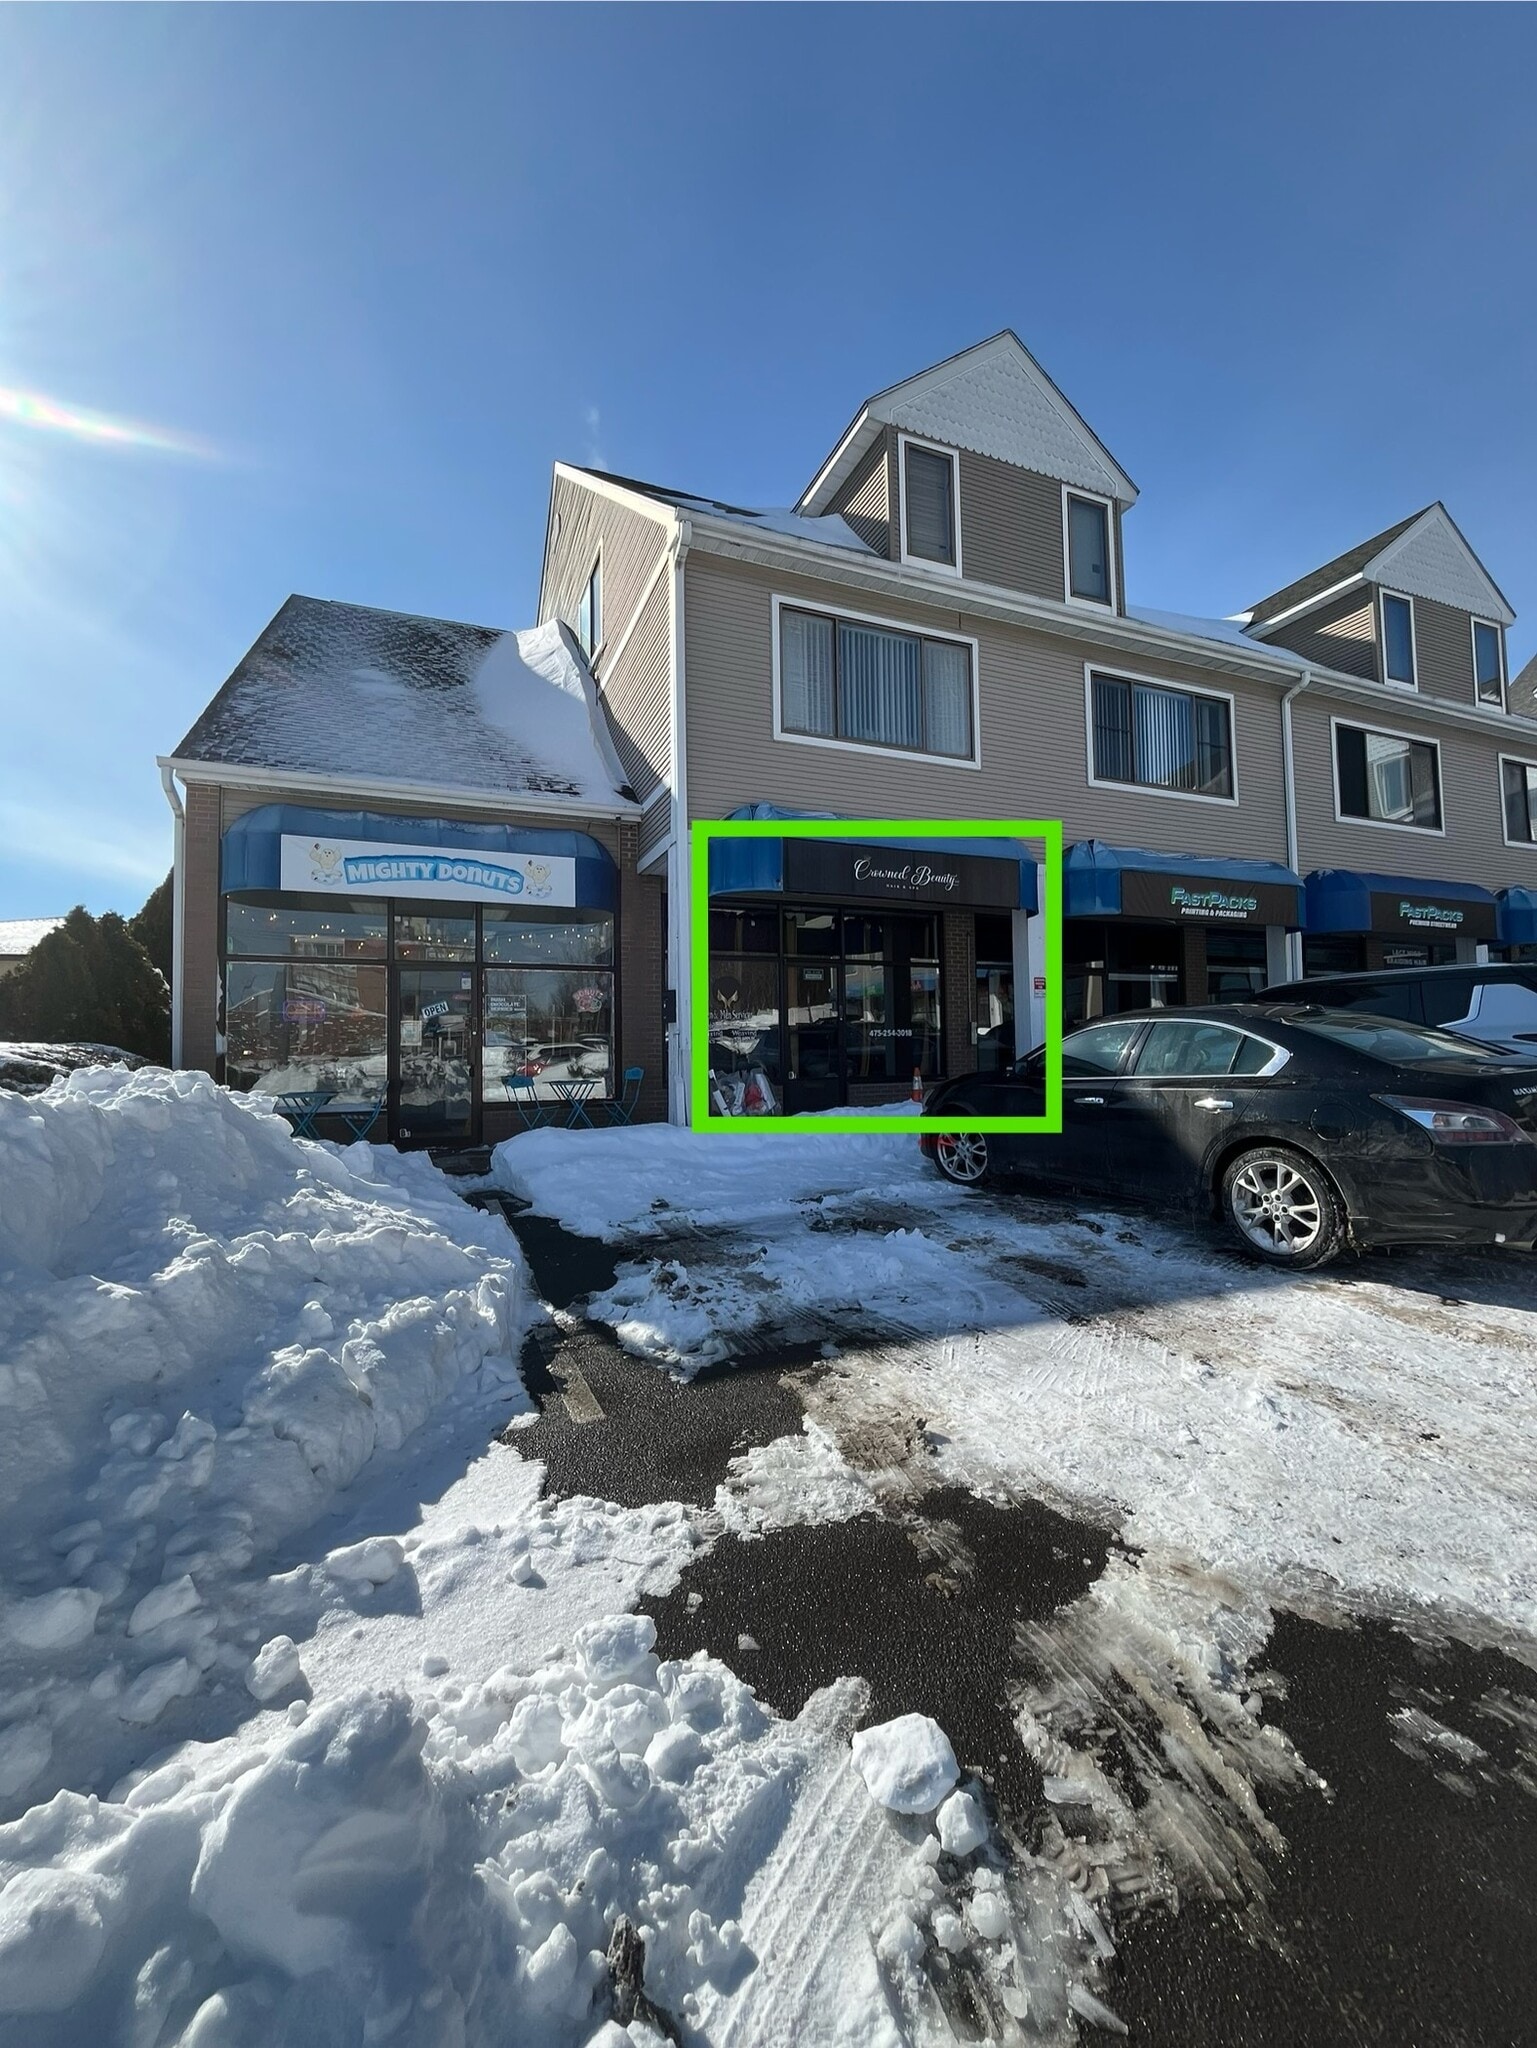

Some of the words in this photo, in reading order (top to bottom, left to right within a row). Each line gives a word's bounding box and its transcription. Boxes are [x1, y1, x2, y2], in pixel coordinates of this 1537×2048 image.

[347, 861, 435, 882] MIGHTY
[438, 863, 522, 893] DONUTS
[854, 859, 911, 881] Crowned
[911, 866, 957, 891] Beauty
[1181, 907, 1209, 916] PRINTING
[1214, 910, 1247, 918] PACKAGING
[424, 1002, 447, 1017] OPEN
[1512, 1086, 1537, 1096] MAXIM
